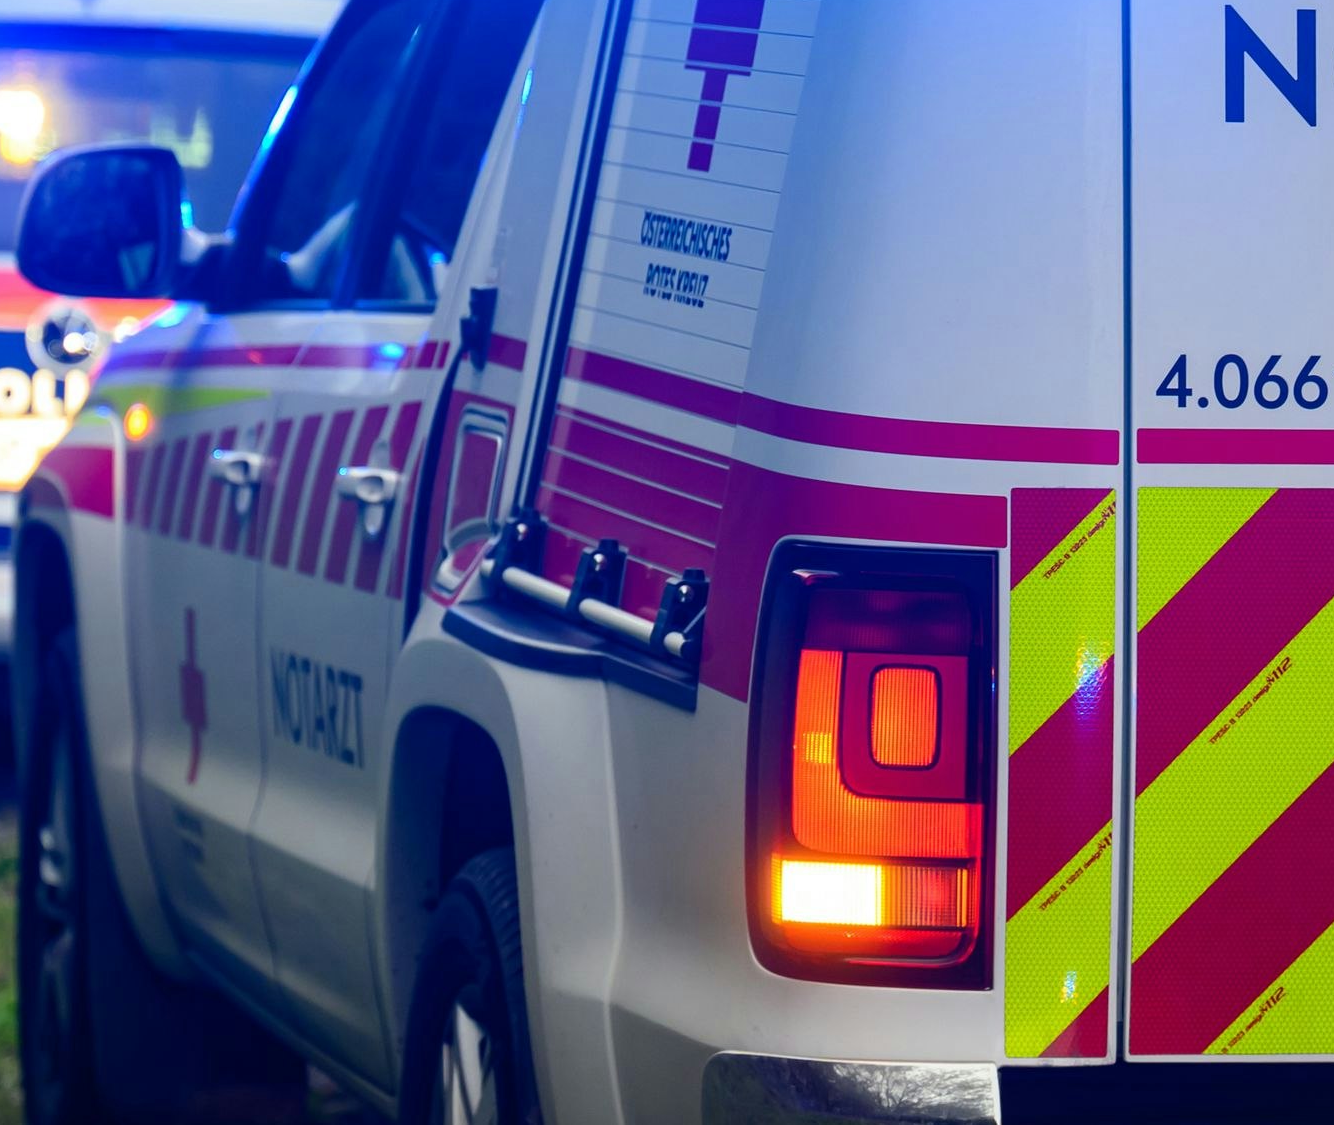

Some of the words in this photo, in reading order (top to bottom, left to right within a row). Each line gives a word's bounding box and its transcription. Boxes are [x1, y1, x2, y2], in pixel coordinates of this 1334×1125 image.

[641, 211, 732, 261] ÖSTERREICHISCHES
[643, 263, 676, 301] ROTES
[270, 649, 364, 769] NOTARZT
